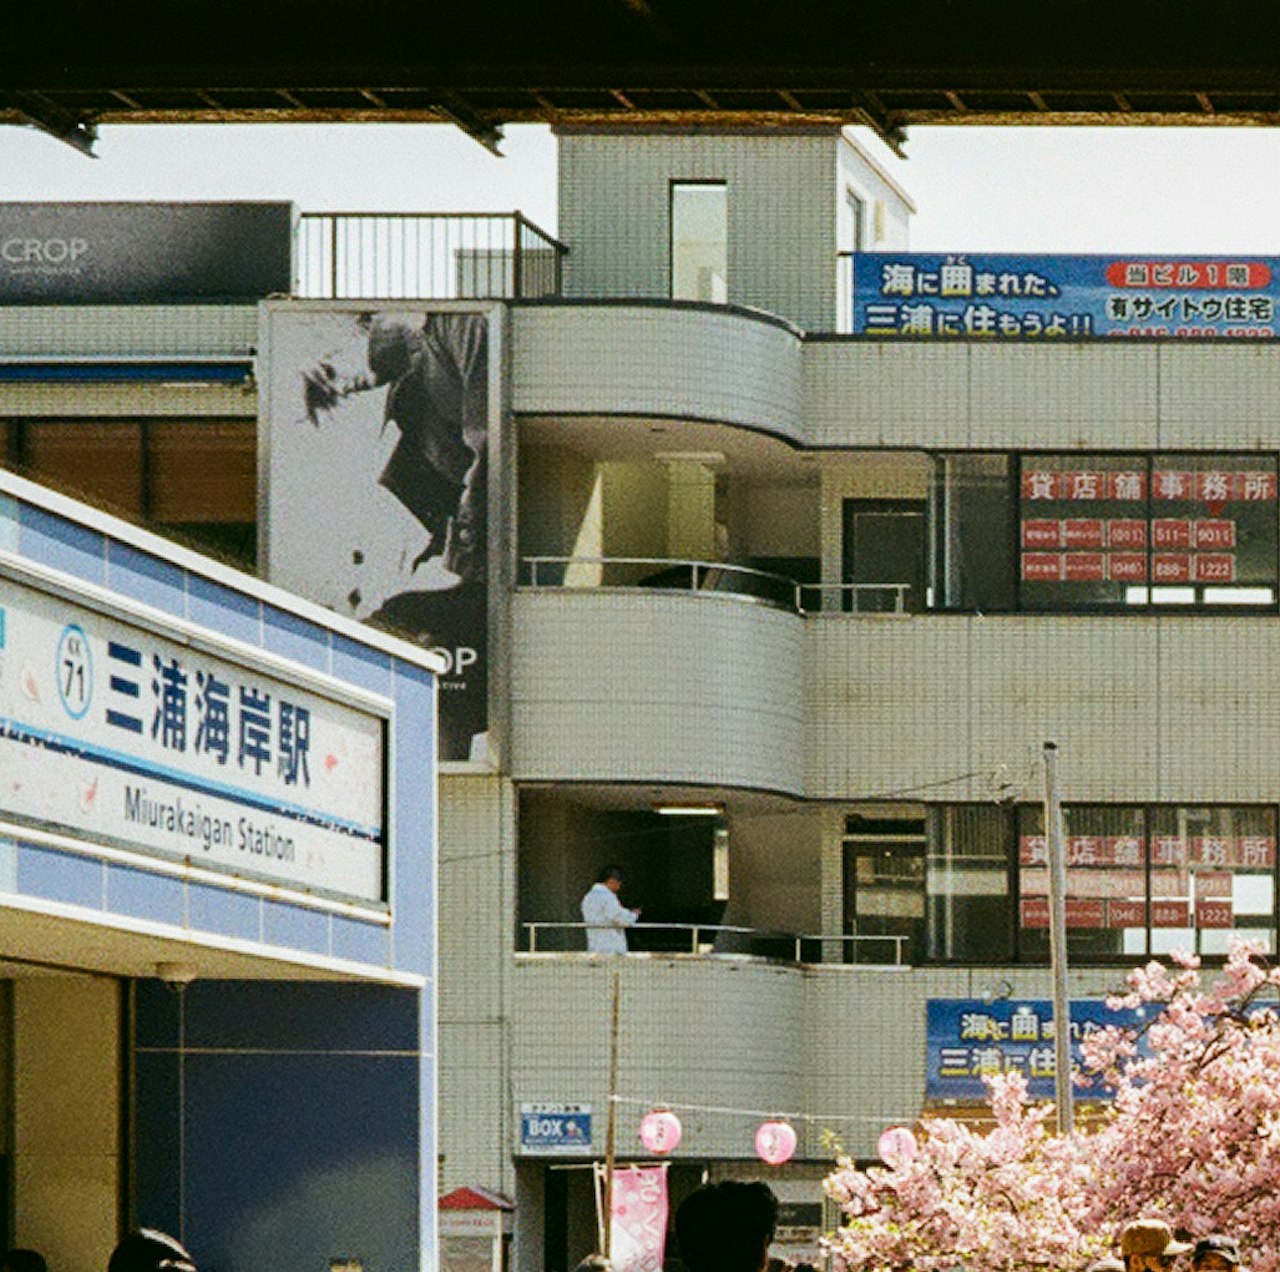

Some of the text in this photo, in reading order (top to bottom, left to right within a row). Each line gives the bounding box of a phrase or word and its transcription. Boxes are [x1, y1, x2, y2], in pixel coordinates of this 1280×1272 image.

[64, 640, 311, 788] 71 三浦海岸駅
[124, 785, 296, 863] Miurakaigan Station
[529, 1119, 564, 1138] BOX
